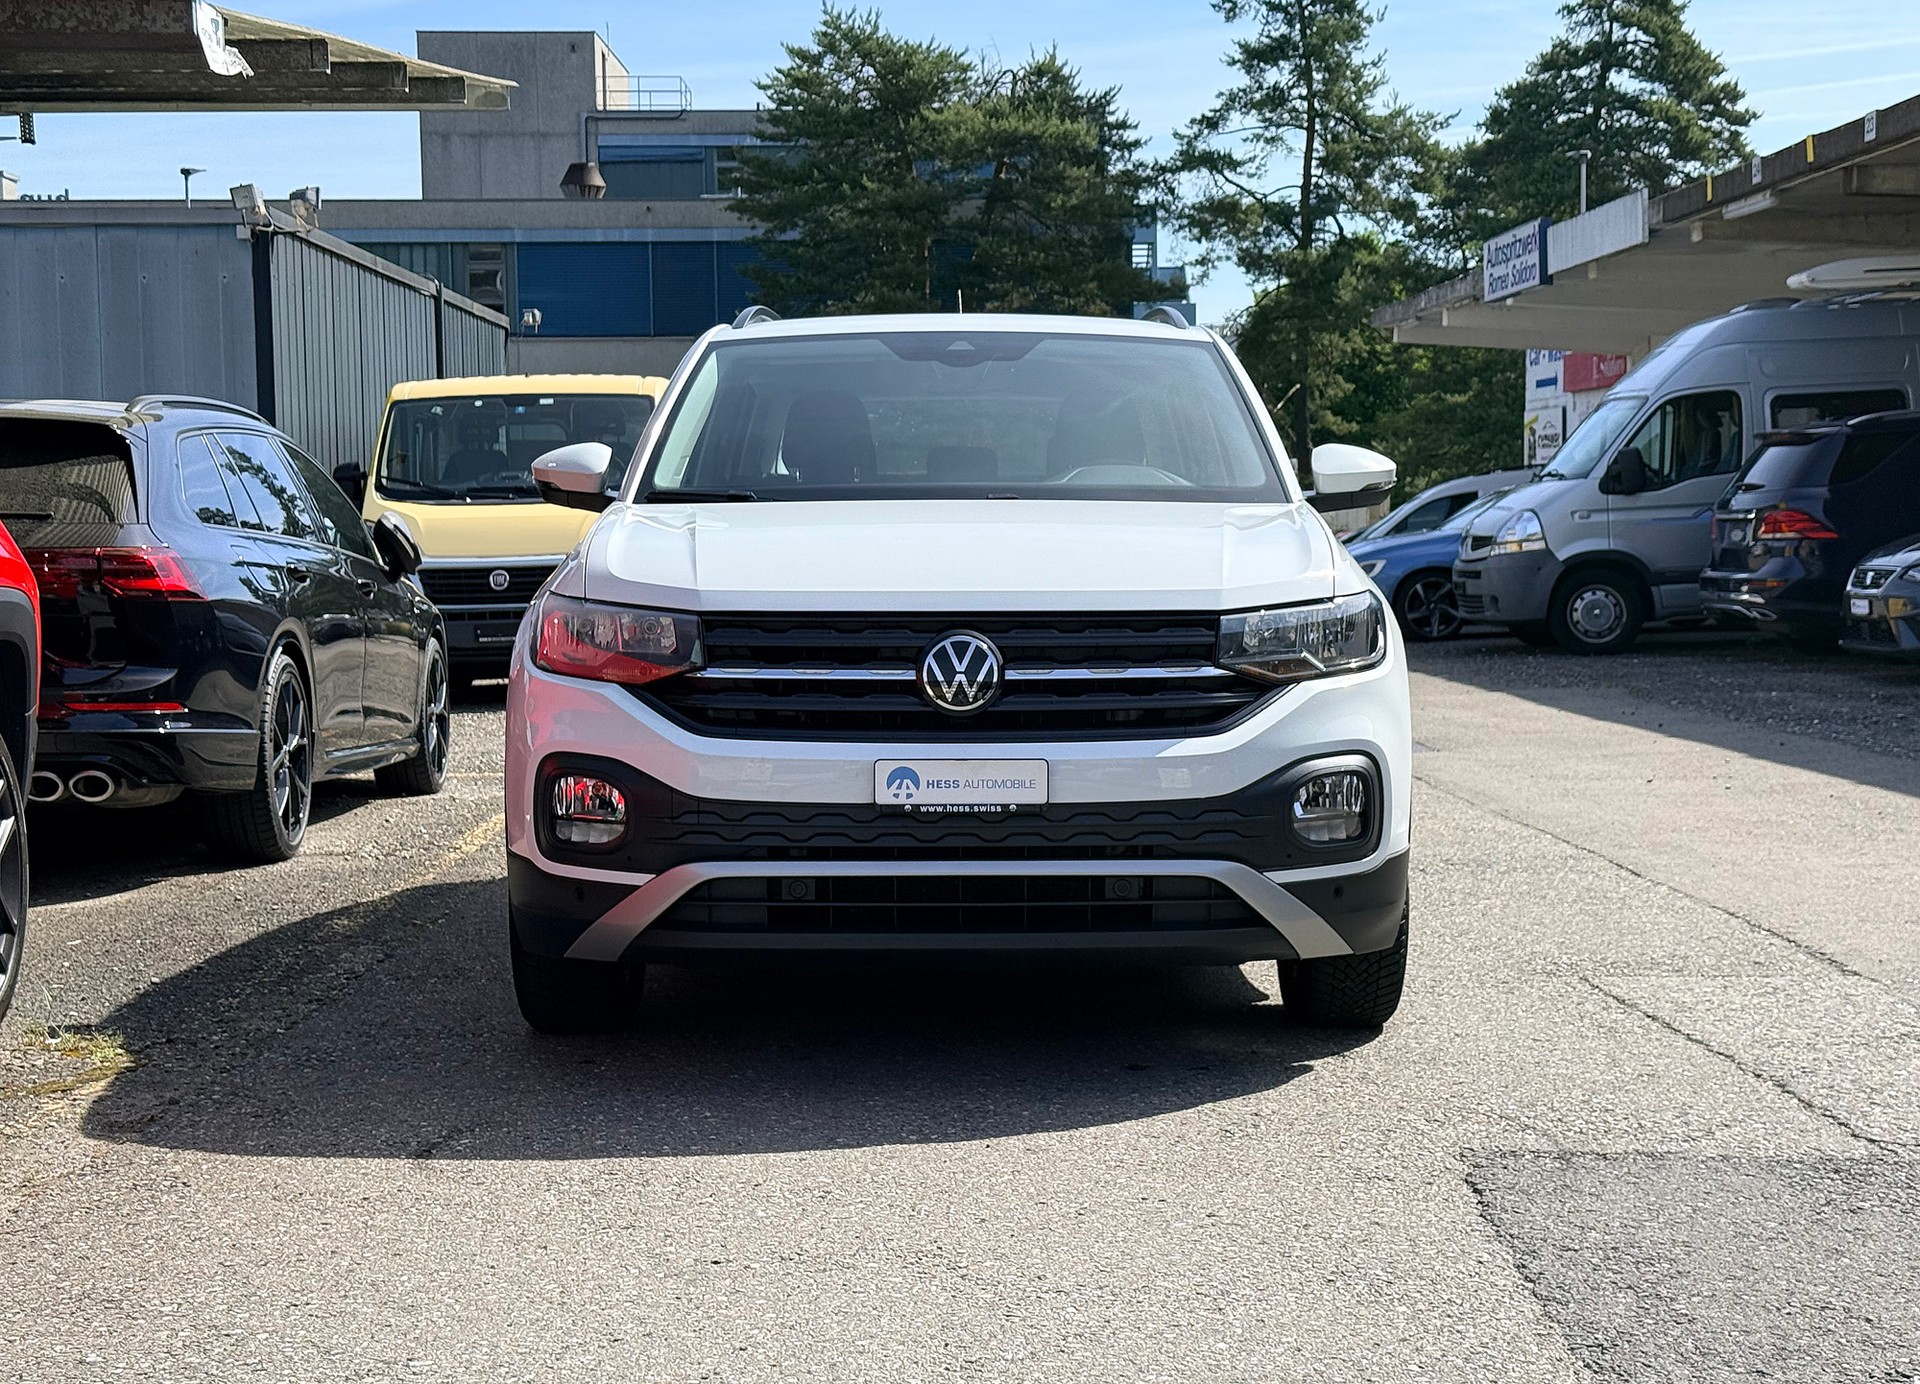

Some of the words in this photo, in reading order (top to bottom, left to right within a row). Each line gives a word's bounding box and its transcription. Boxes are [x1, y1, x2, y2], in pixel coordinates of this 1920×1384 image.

[926, 779, 960, 789] HESS
[963, 778, 1037, 789] AUTOMOBILE
[919, 803, 1002, 813] www.hess.swiss
